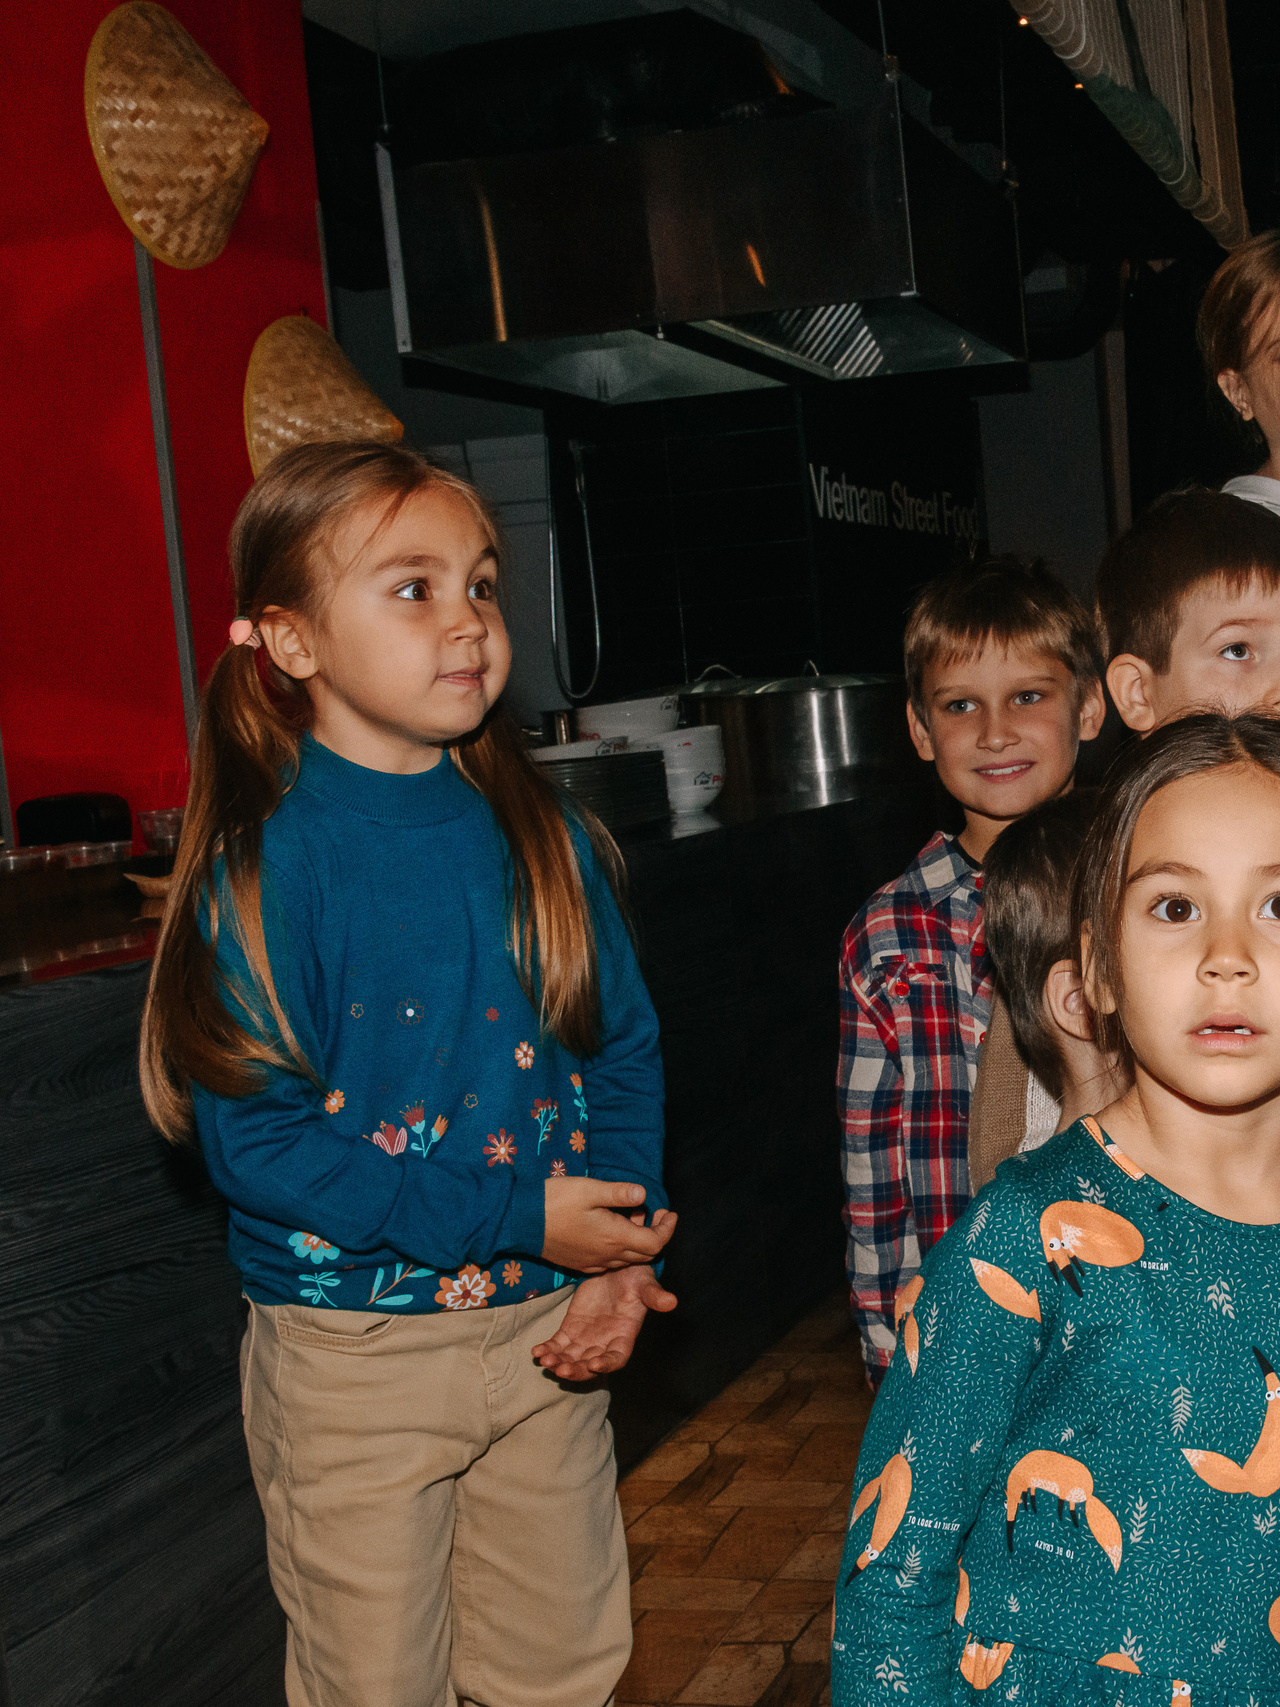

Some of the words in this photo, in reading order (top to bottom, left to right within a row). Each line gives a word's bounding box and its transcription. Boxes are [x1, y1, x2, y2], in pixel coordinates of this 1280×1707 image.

[808, 462, 888, 528] Vietnam
[891, 480, 941, 535] Street
[1140, 1260, 1147, 1269] TO
[1148, 1261, 1169, 1271] DREAM
[908, 1515, 916, 1525] TO
[917, 1518, 933, 1528] LOOK
[934, 1520, 942, 1529] AT
[1034, 1540, 1054, 1553] CRAZY
[1055, 1546, 1064, 1556] BE
[1065, 1549, 1074, 1559] TO
